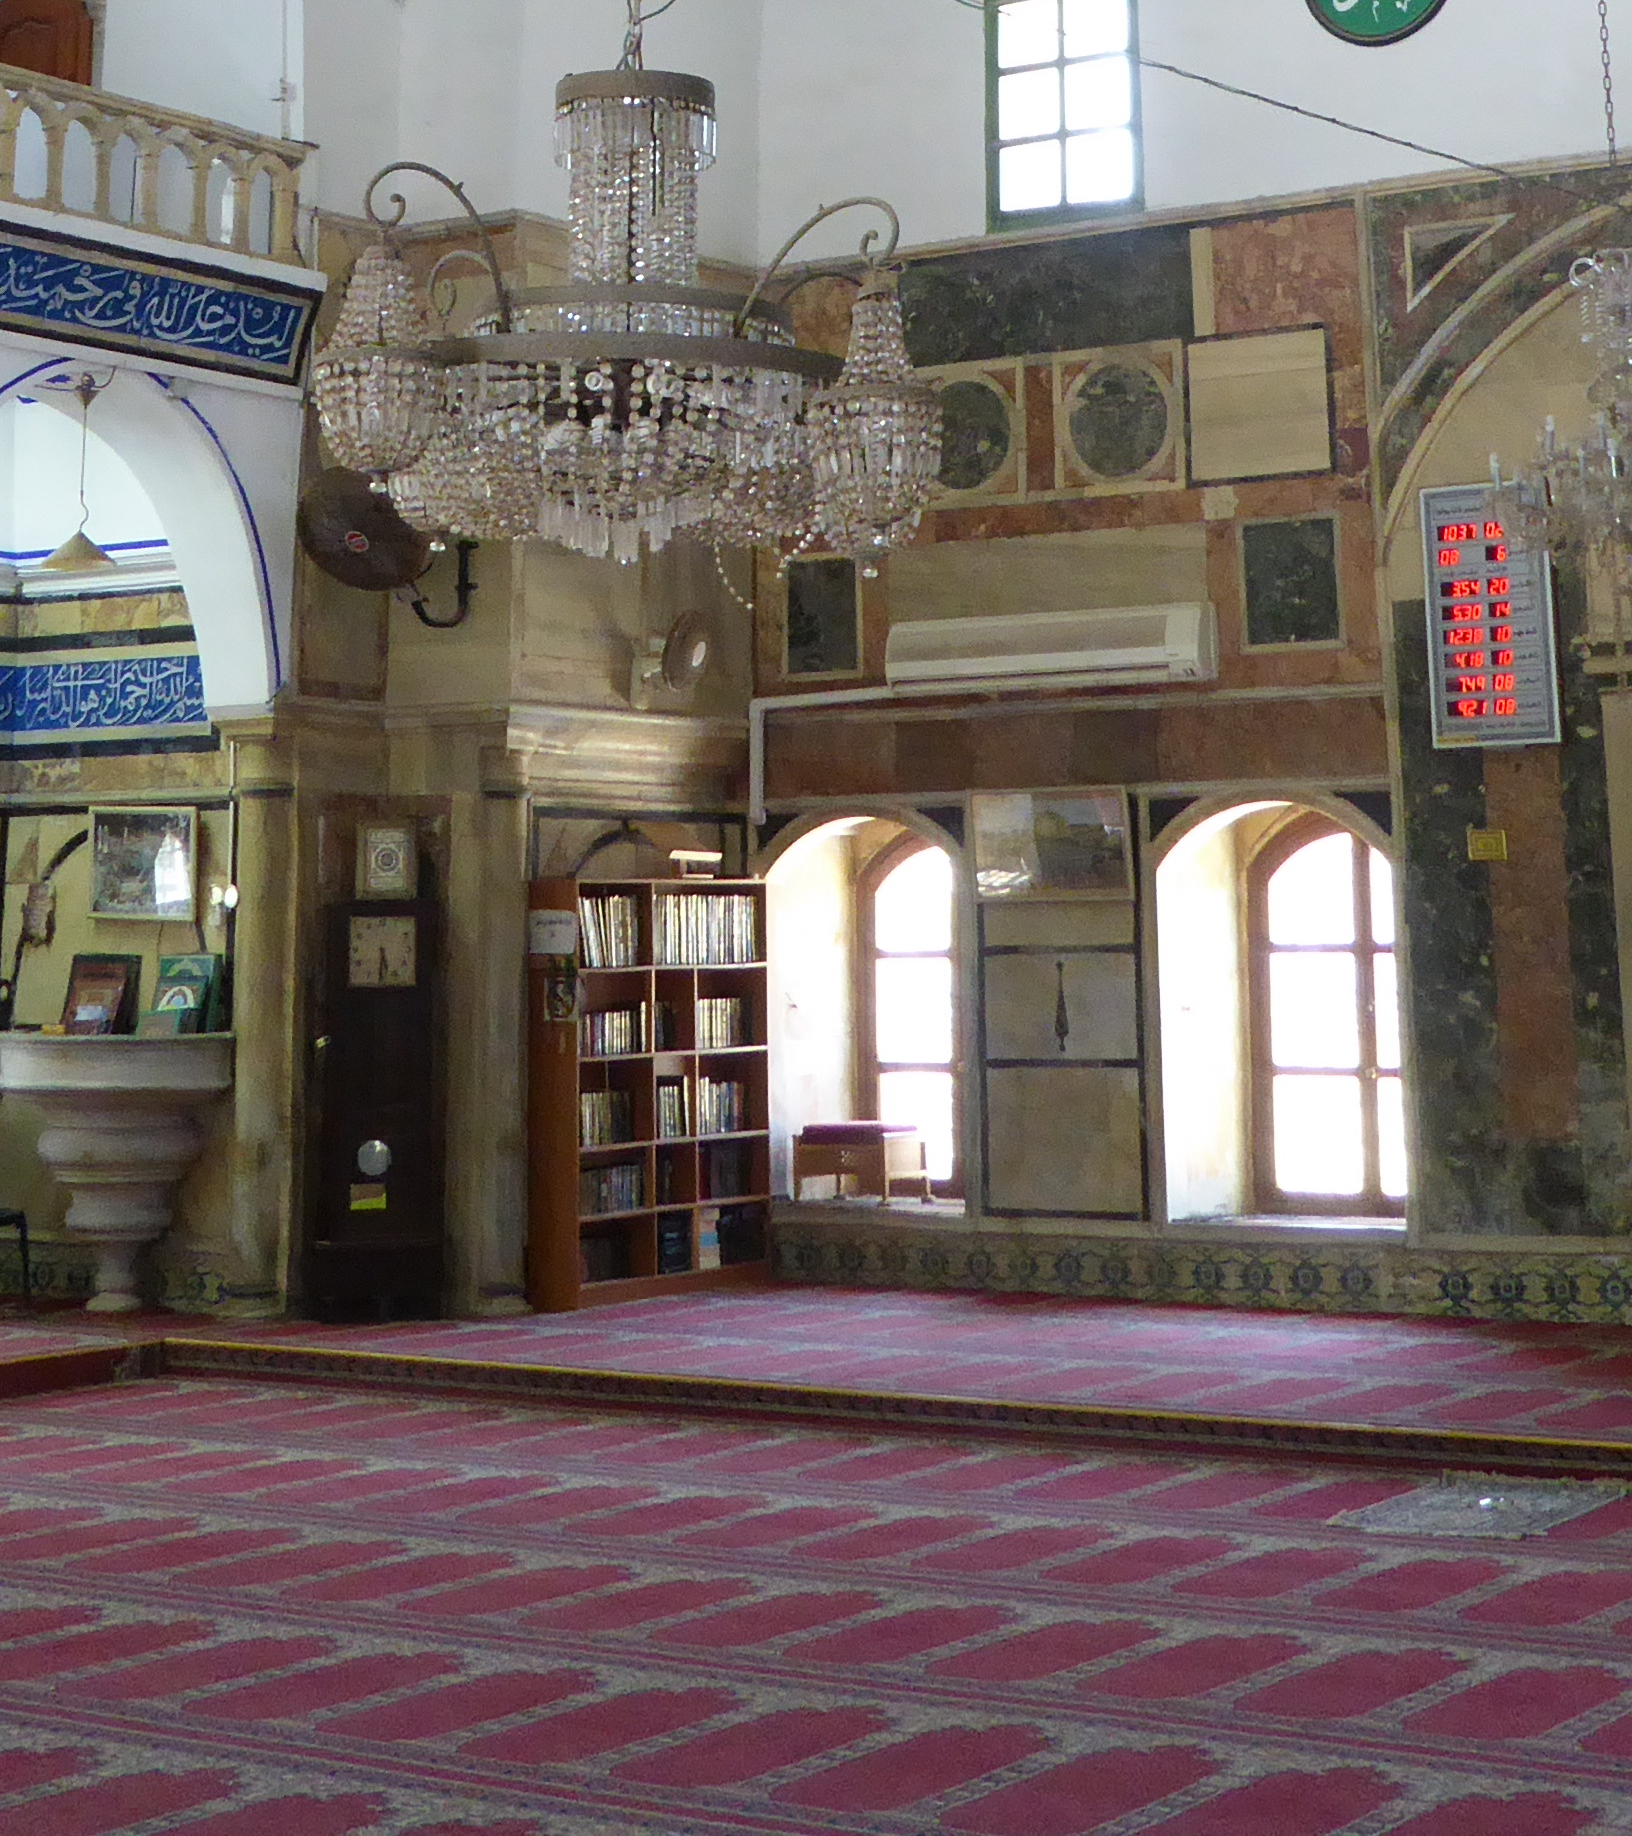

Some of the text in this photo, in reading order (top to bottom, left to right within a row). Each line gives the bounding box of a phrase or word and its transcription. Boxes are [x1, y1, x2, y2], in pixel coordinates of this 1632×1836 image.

[1496, 546, 1506, 561] 6
[1489, 579, 1509, 595] 20
[1496, 603, 1510, 617] 14
[1497, 626, 1511, 642] 10
[1498, 651, 1513, 665] 10
